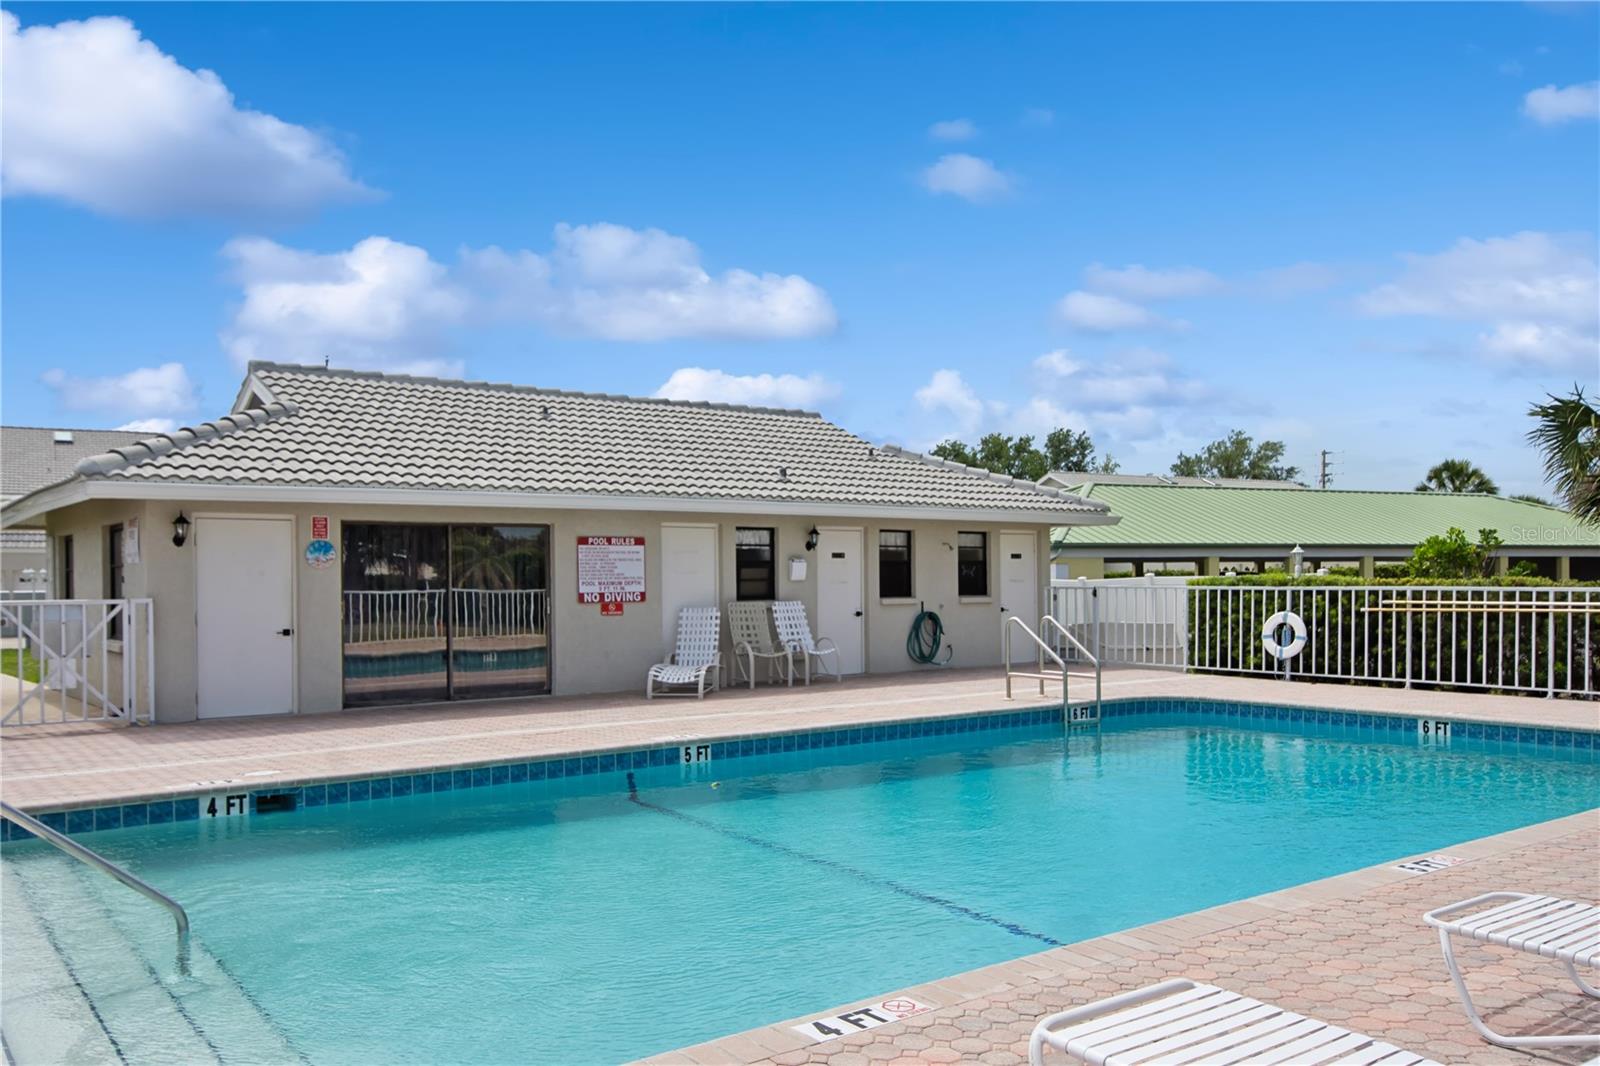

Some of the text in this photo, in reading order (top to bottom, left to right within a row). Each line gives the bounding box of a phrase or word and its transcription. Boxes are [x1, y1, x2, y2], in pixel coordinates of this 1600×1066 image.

[588, 537, 635, 545] POOL RULES
[584, 592, 641, 602] NO DIVING
[1073, 707, 1088, 720] 6 FT
[1423, 720, 1449, 736] 6 FT
[685, 745, 710, 763] 5 FT
[207, 794, 247, 817] 4 FT
[1411, 859, 1448, 869] FT
[812, 1021, 843, 1036] 4
[838, 1008, 888, 1029] FT
